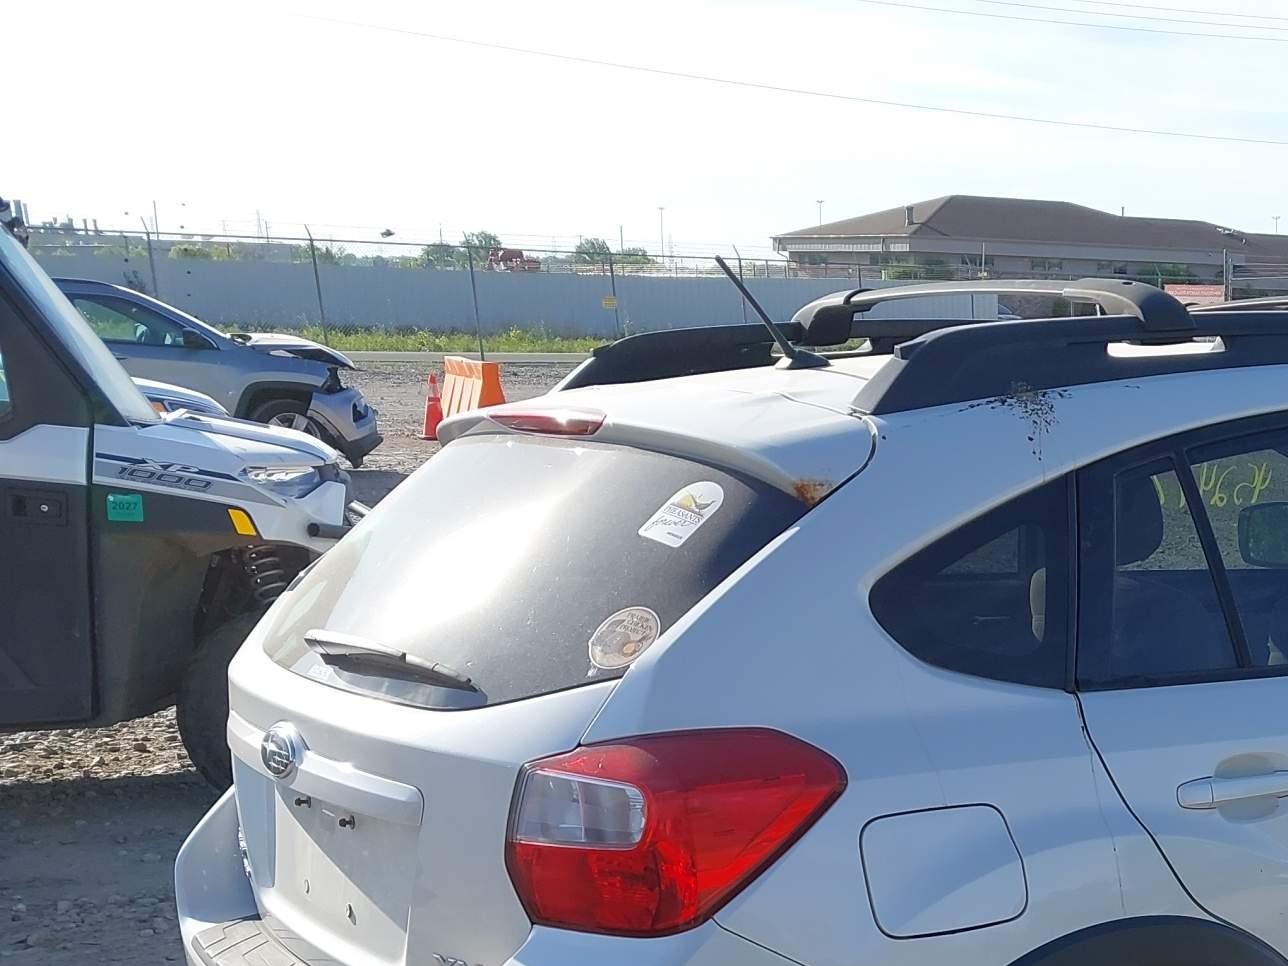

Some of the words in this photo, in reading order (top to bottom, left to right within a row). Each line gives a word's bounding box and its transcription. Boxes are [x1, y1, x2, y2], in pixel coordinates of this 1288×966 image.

[130, 457, 200, 473] XP
[118, 466, 213, 492] 1000
[112, 502, 138, 512] 2027
